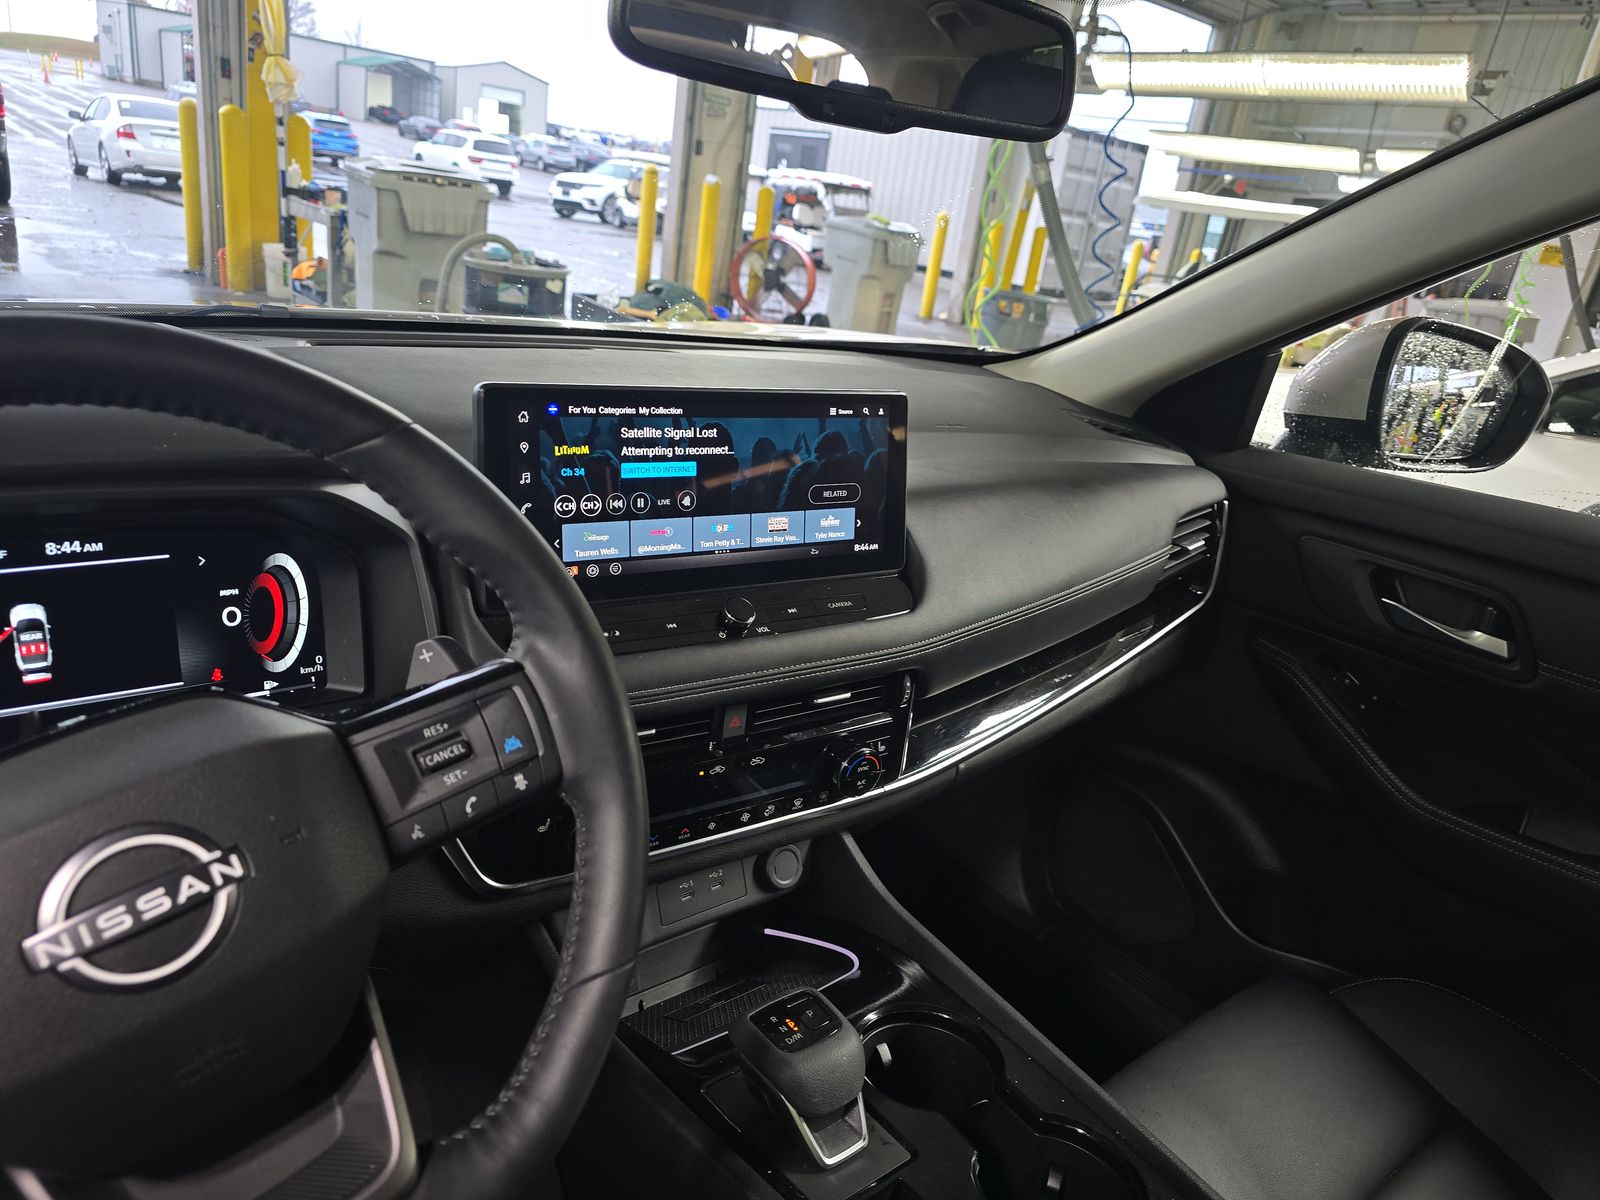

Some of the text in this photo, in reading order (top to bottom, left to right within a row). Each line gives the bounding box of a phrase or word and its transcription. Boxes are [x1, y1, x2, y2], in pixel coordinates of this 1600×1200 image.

[568, 406, 596, 414] For You
[599, 406, 636, 416] Categories
[639, 406, 683, 416] My Collection
[620, 426, 718, 440] Satellite Signal Lost
[620, 446, 673, 458] Attempting
[674, 446, 684, 456] to
[561, 468, 585, 476] Ch 34
[622, 466, 696, 474] SWITCH TO INTERNET
[823, 490, 848, 498] RELATED
[756, 536, 772, 544] Stevie
[814, 532, 828, 540] Tyler
[45, 540, 104, 556] 8:44 AM
[700, 540, 714, 548] Tom
[714, 540, 730, 548] Petty
[854, 543, 868, 552] 8:44
[574, 548, 619, 558] Tauren Wells
[220, 588, 239, 596] MPH
[827, 600, 853, 608] CAMERA
[756, 626, 770, 634] VOL
[315, 656, 323, 664] 0
[300, 664, 324, 674] km/h
[423, 723, 449, 738] RES+
[426, 744, 466, 766] CANCEL
[33, 853, 244, 969] NISSAN
[806, 1010, 814, 1018] P
[784, 1032, 804, 1045] D/M
